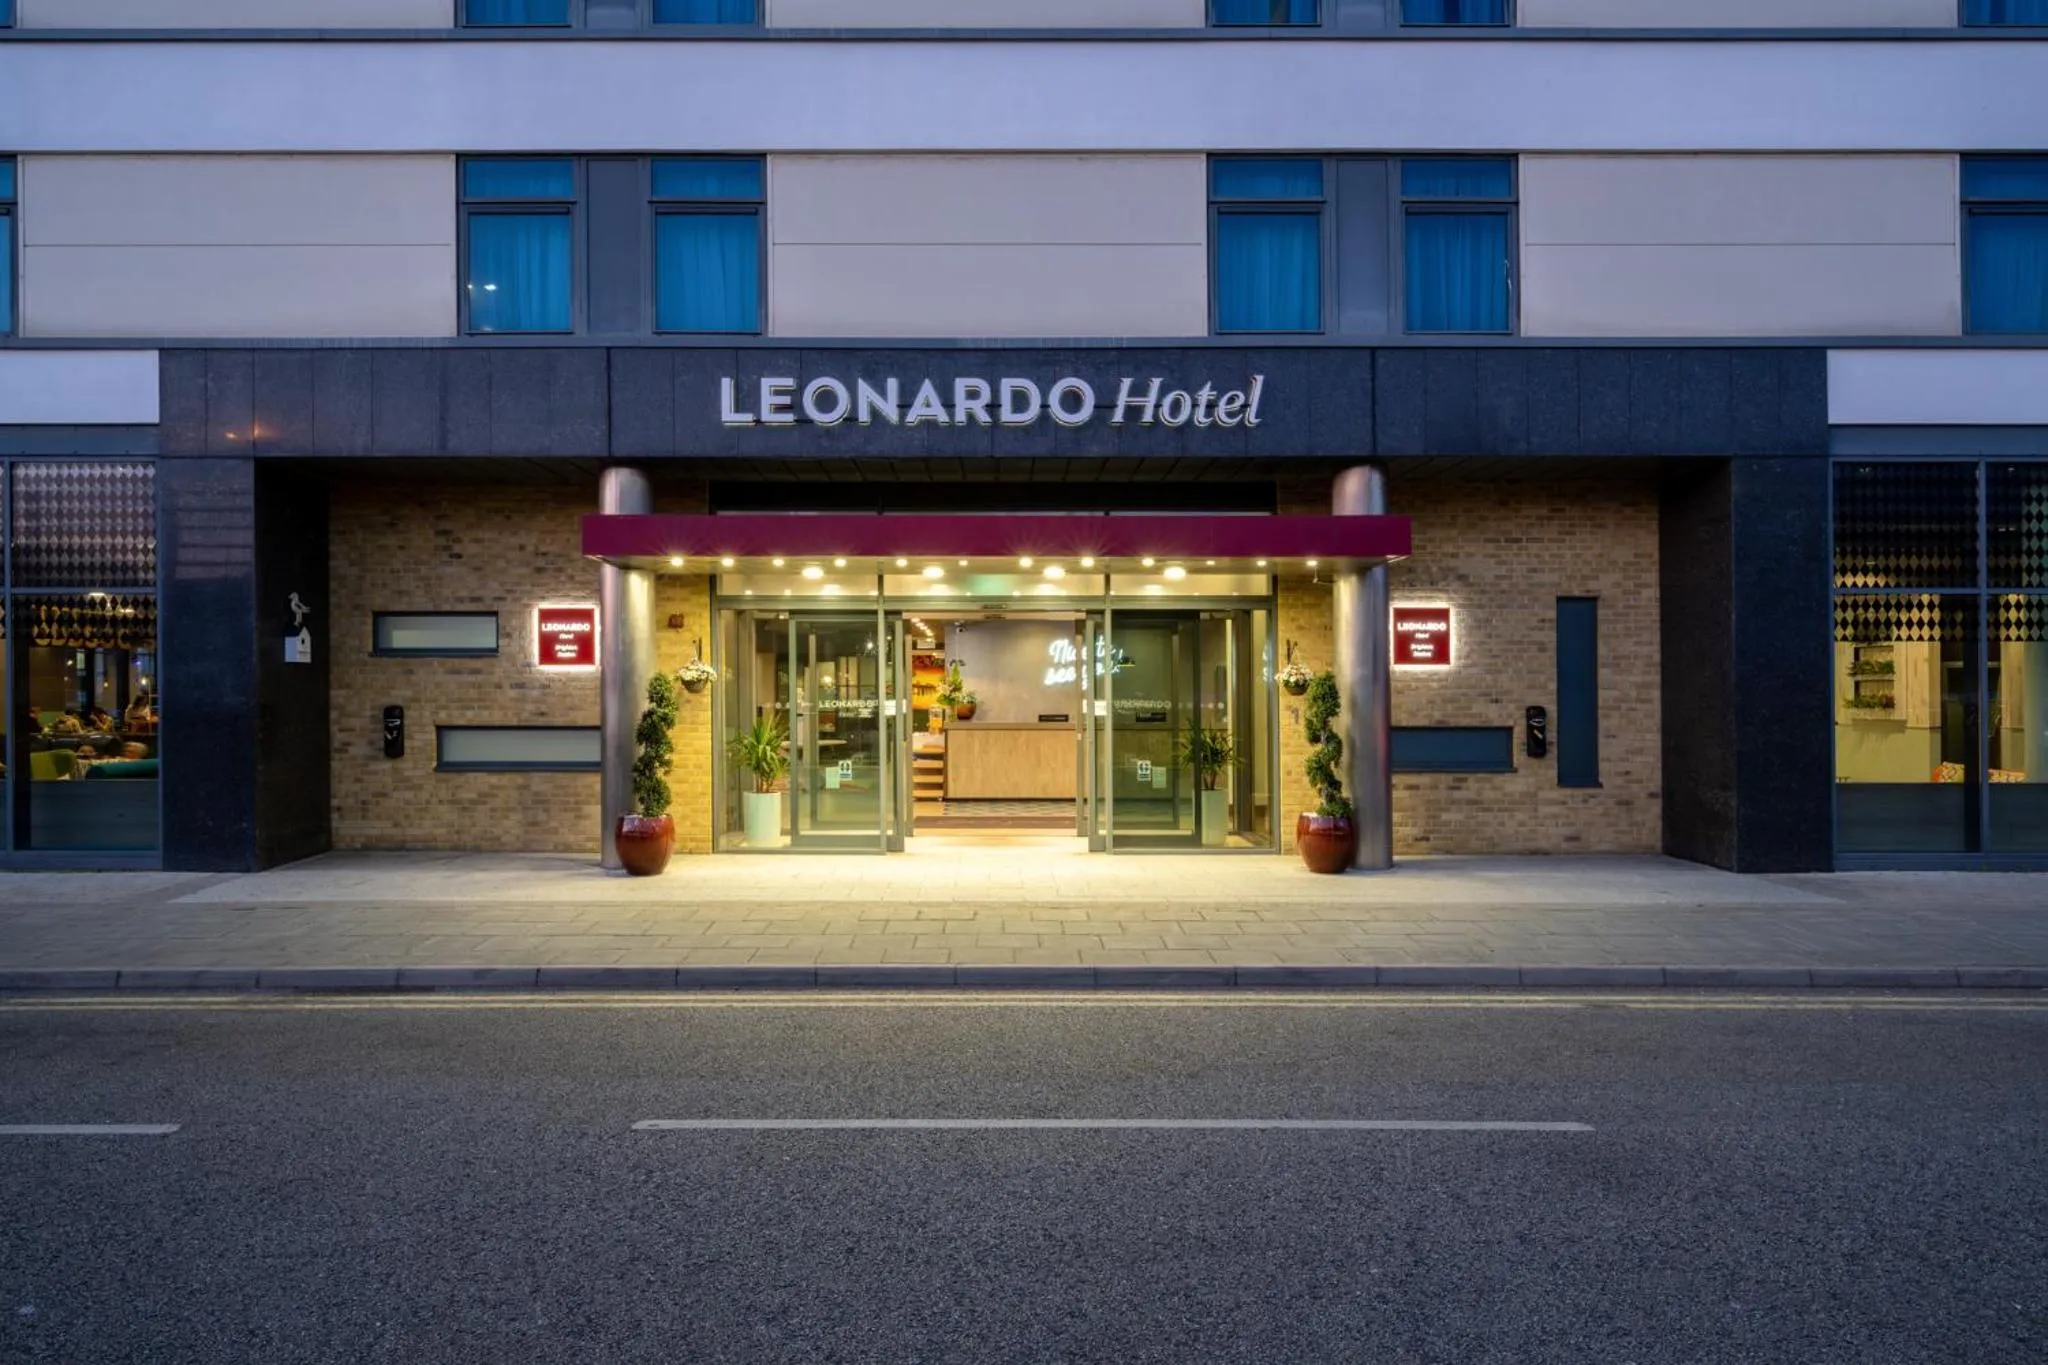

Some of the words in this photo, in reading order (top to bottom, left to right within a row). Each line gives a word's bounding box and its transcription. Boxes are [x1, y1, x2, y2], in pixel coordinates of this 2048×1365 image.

[721, 376, 1095, 426] LEONARDO
[1110, 375, 1264, 427] Hotel
[541, 622, 591, 632] LEONARDO
[1397, 622, 1447, 631] LEONARDO
